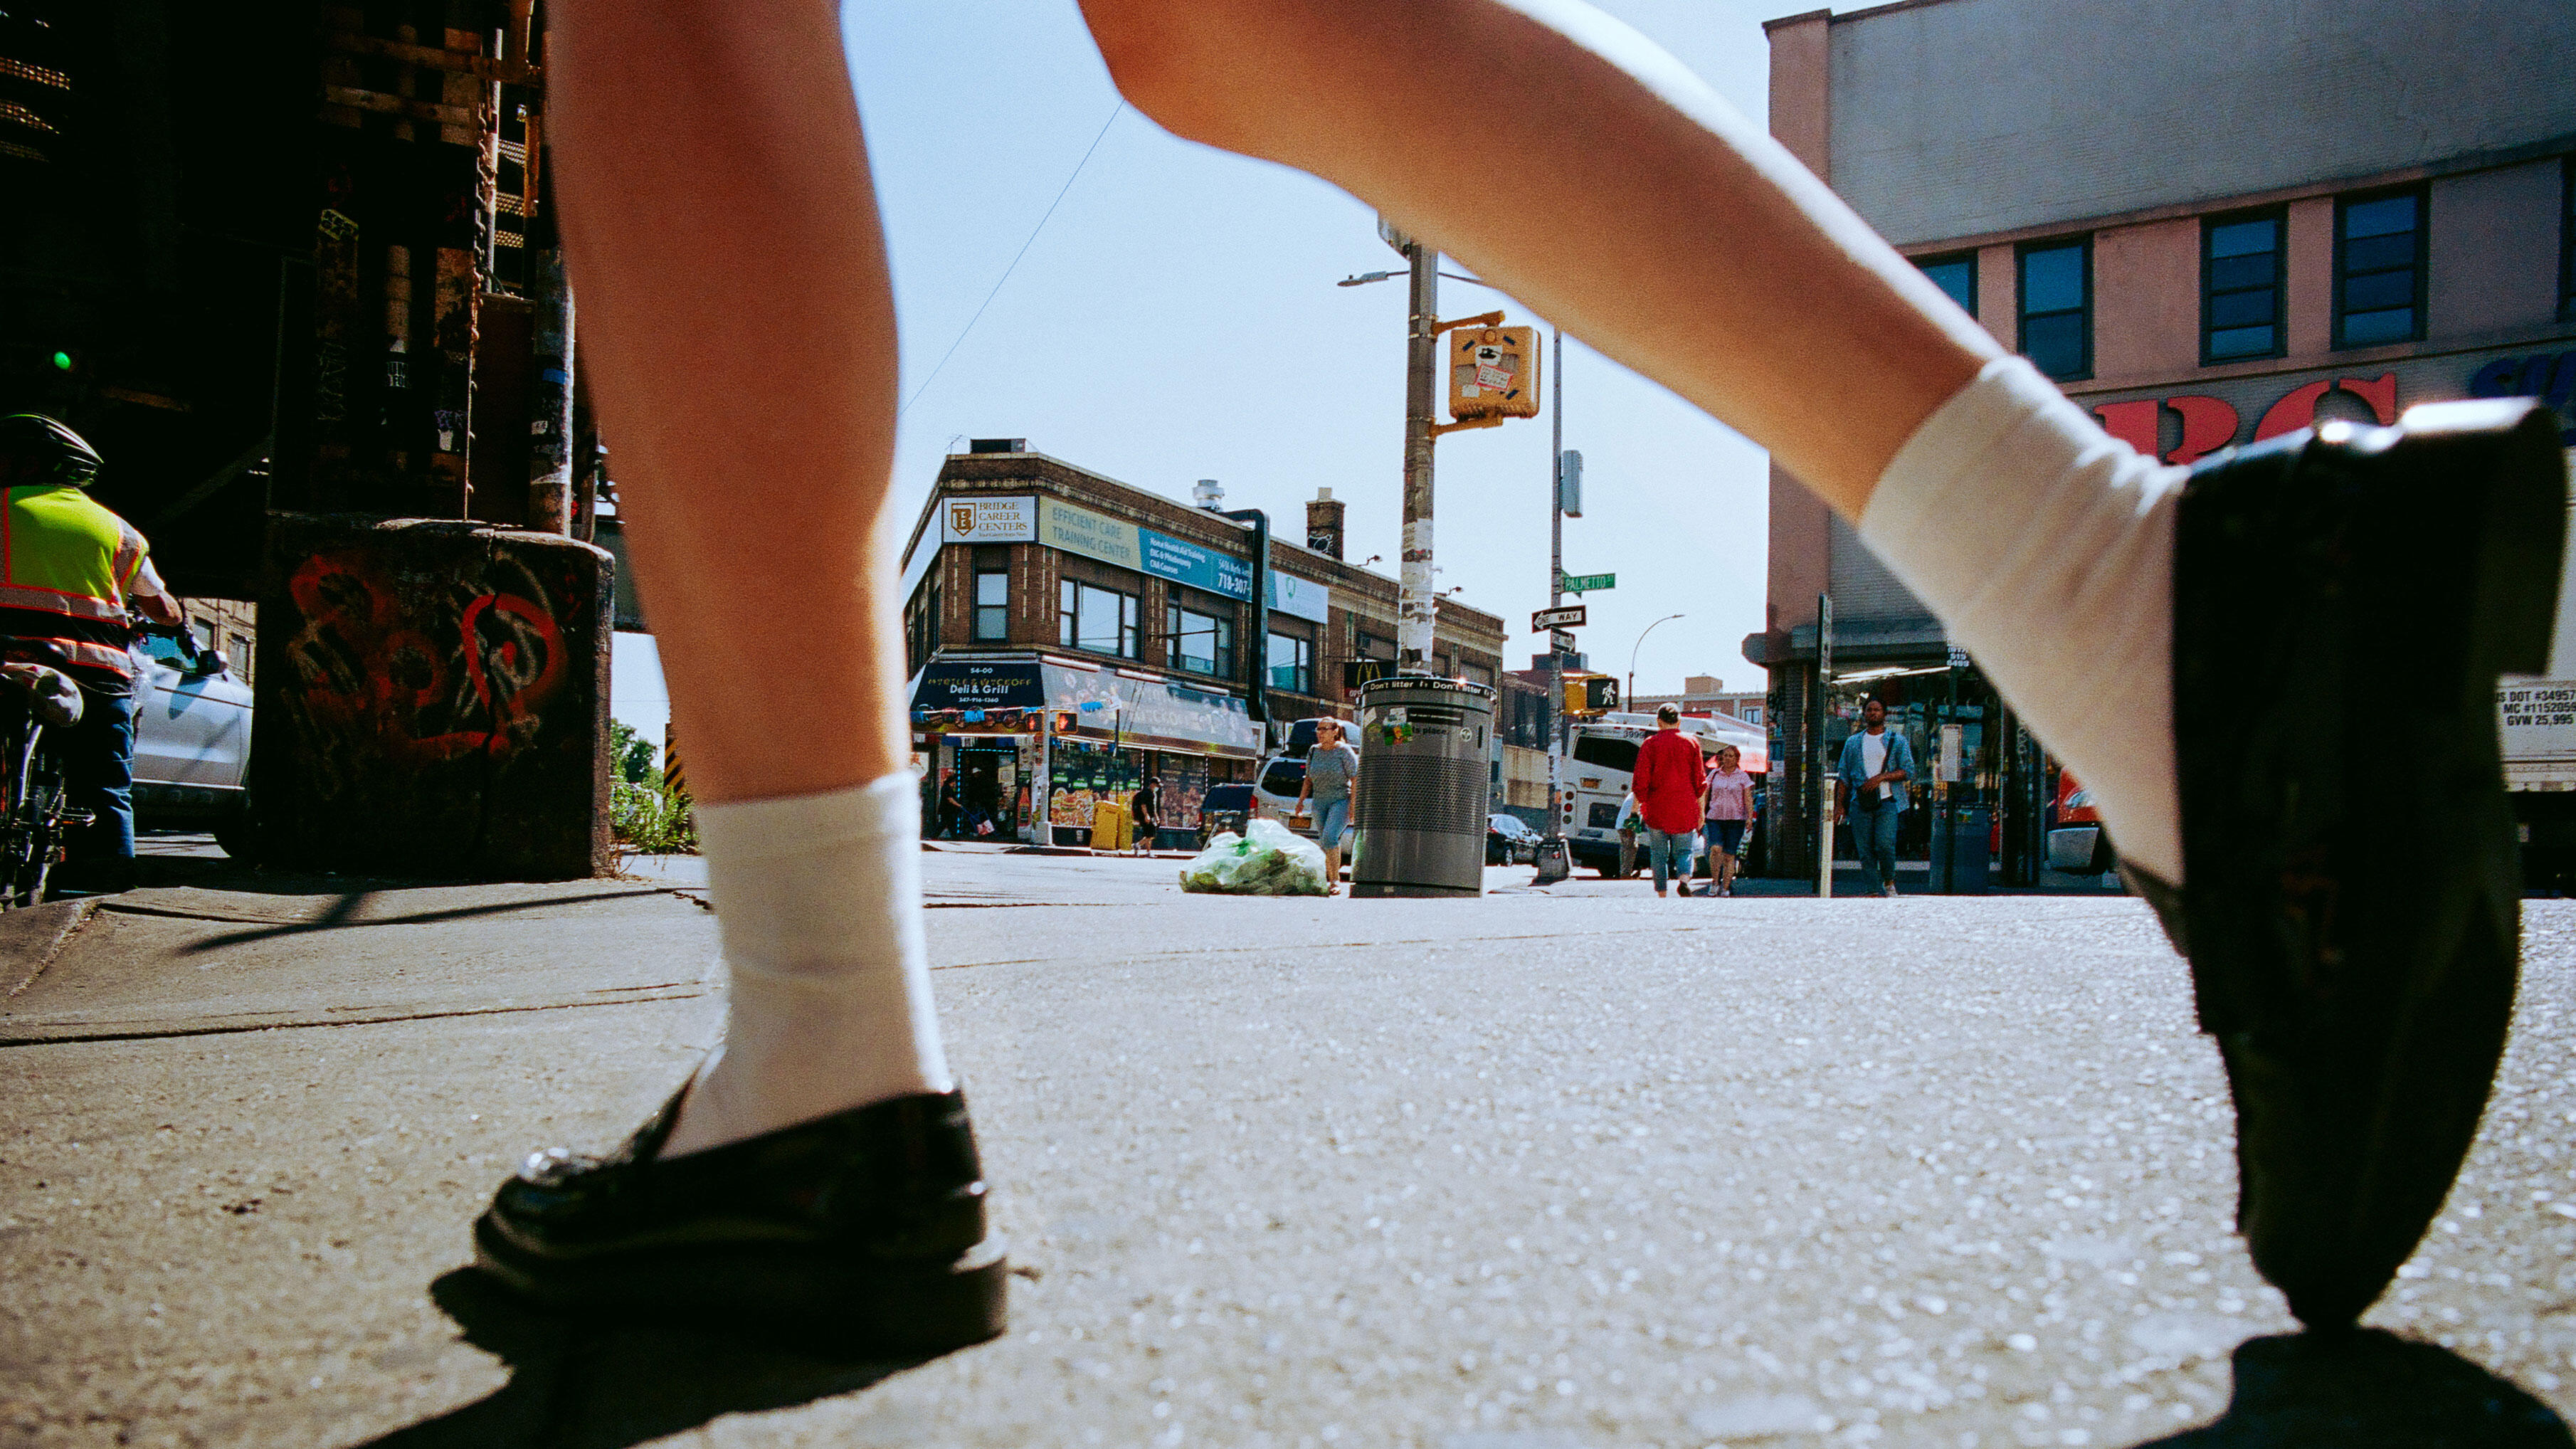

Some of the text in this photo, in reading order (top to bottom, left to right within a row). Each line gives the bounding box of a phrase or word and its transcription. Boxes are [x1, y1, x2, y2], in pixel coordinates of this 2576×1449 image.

[979, 502, 1019, 510] BRIDGE
[979, 522, 1028, 531] CENTERS
[1052, 506, 1122, 539] EFFICIENT CARE
[1052, 525, 1130, 559] TRAINING CENTER
[1218, 572, 1252, 595] 718-307-
[1565, 576, 1606, 591] PALMETTO
[1557, 612, 1578, 621] WAY
[950, 685, 1009, 694] Deli & Grill
[1370, 682, 1389, 690] Don't
[1432, 681, 1459, 690] Don't
[1462, 685, 1481, 694] litter
[2509, 691, 2531, 702] DOT
[2503, 703, 2520, 714] MC
[2506, 714, 2574, 726] GVW 25,995
